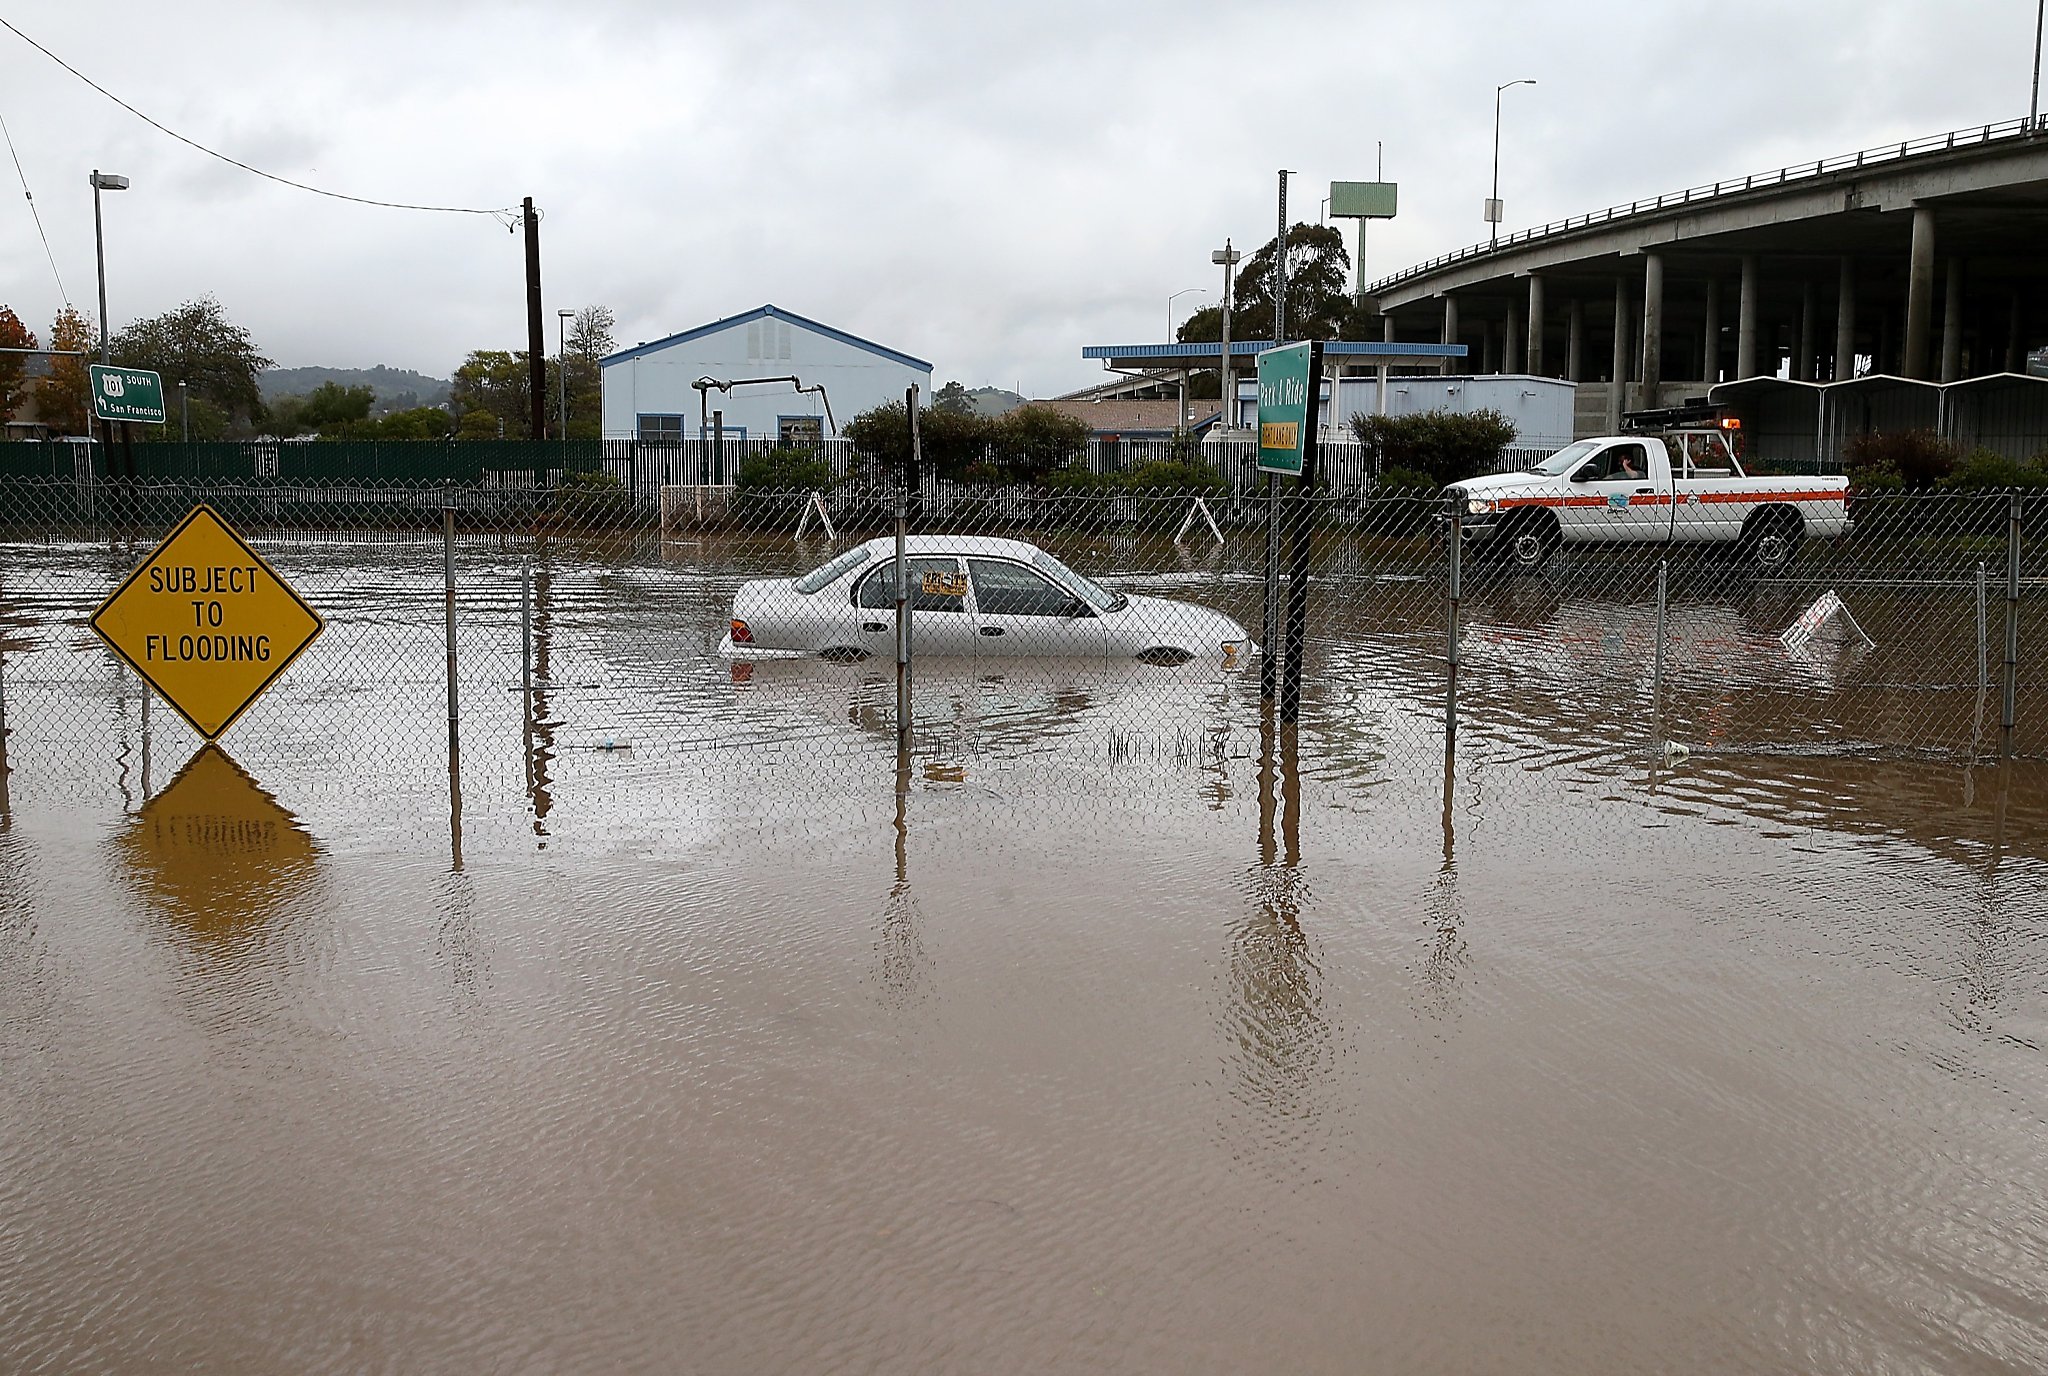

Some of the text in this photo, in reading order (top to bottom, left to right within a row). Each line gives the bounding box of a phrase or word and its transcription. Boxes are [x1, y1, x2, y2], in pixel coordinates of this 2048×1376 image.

[106, 380, 121, 392] 101
[126, 375, 152, 387] SOUTH
[1260, 382, 1276, 407] Park
[1285, 376, 1304, 405] Ride
[110, 403, 162, 417] San Francisco
[149, 566, 259, 594] SUBJECT
[191, 601, 224, 628] TO
[145, 635, 271, 662] FLOODING
